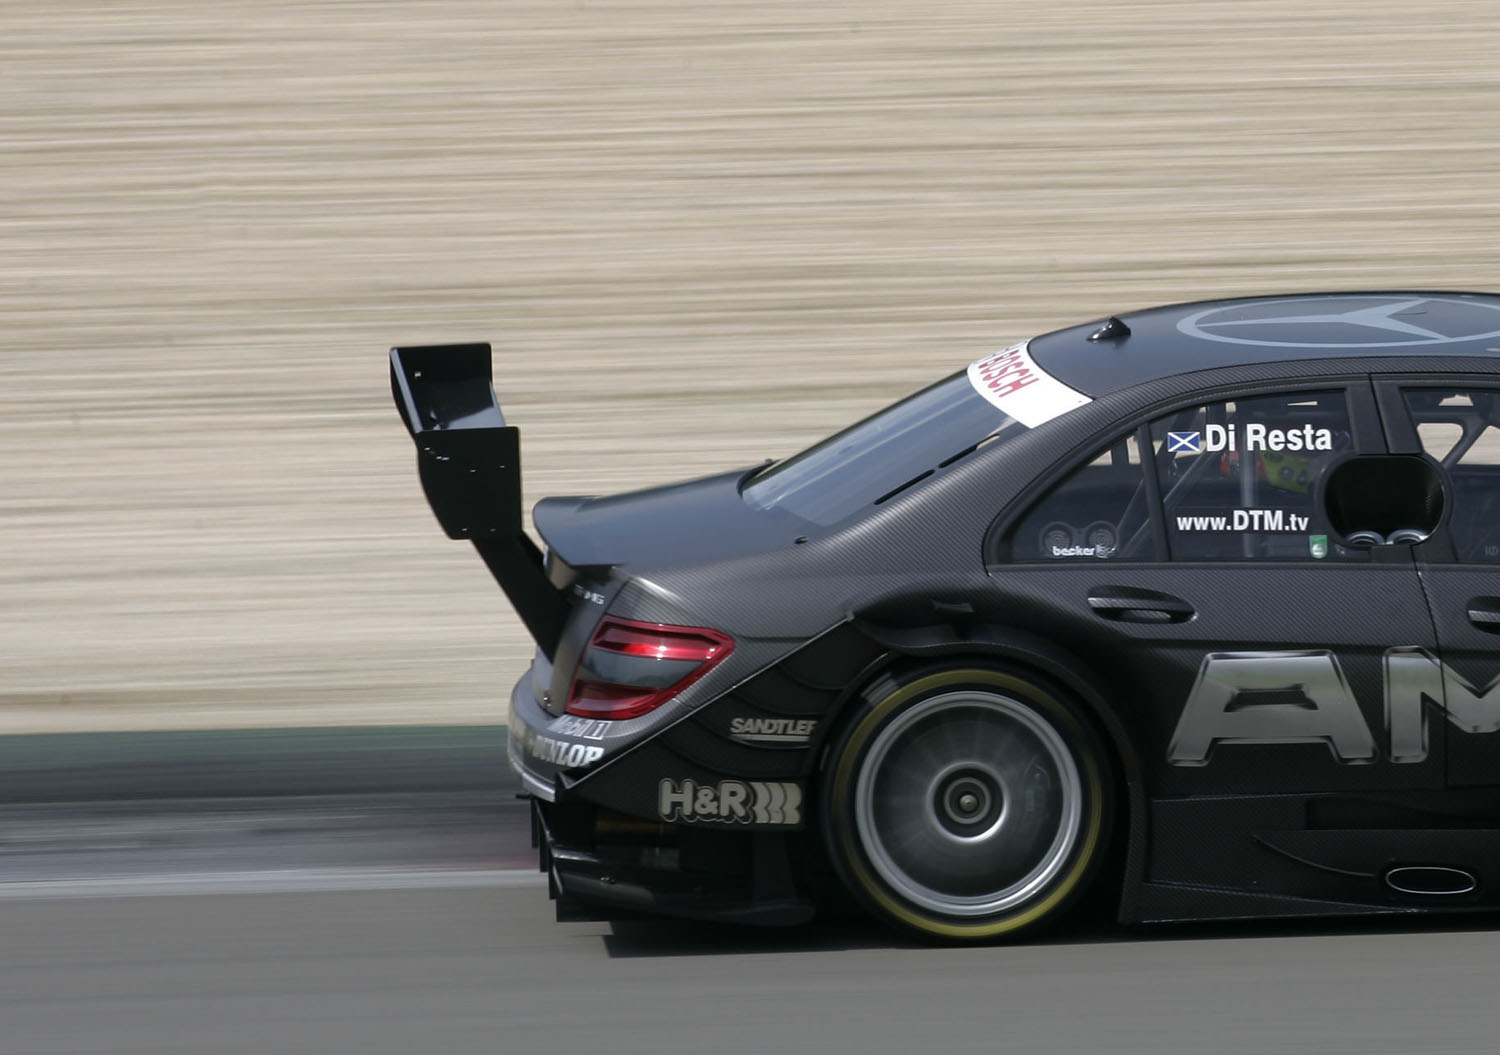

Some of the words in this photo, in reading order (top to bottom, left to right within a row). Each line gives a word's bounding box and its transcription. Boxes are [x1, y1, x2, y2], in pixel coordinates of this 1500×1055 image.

[978, 349, 1040, 398] BOSCH
[1206, 424, 1236, 452] Di
[1247, 423, 1332, 451] Resta
[1177, 510, 1309, 531] www.DTM.tv
[1052, 545, 1095, 556] becker
[660, 779, 752, 822] H&R
